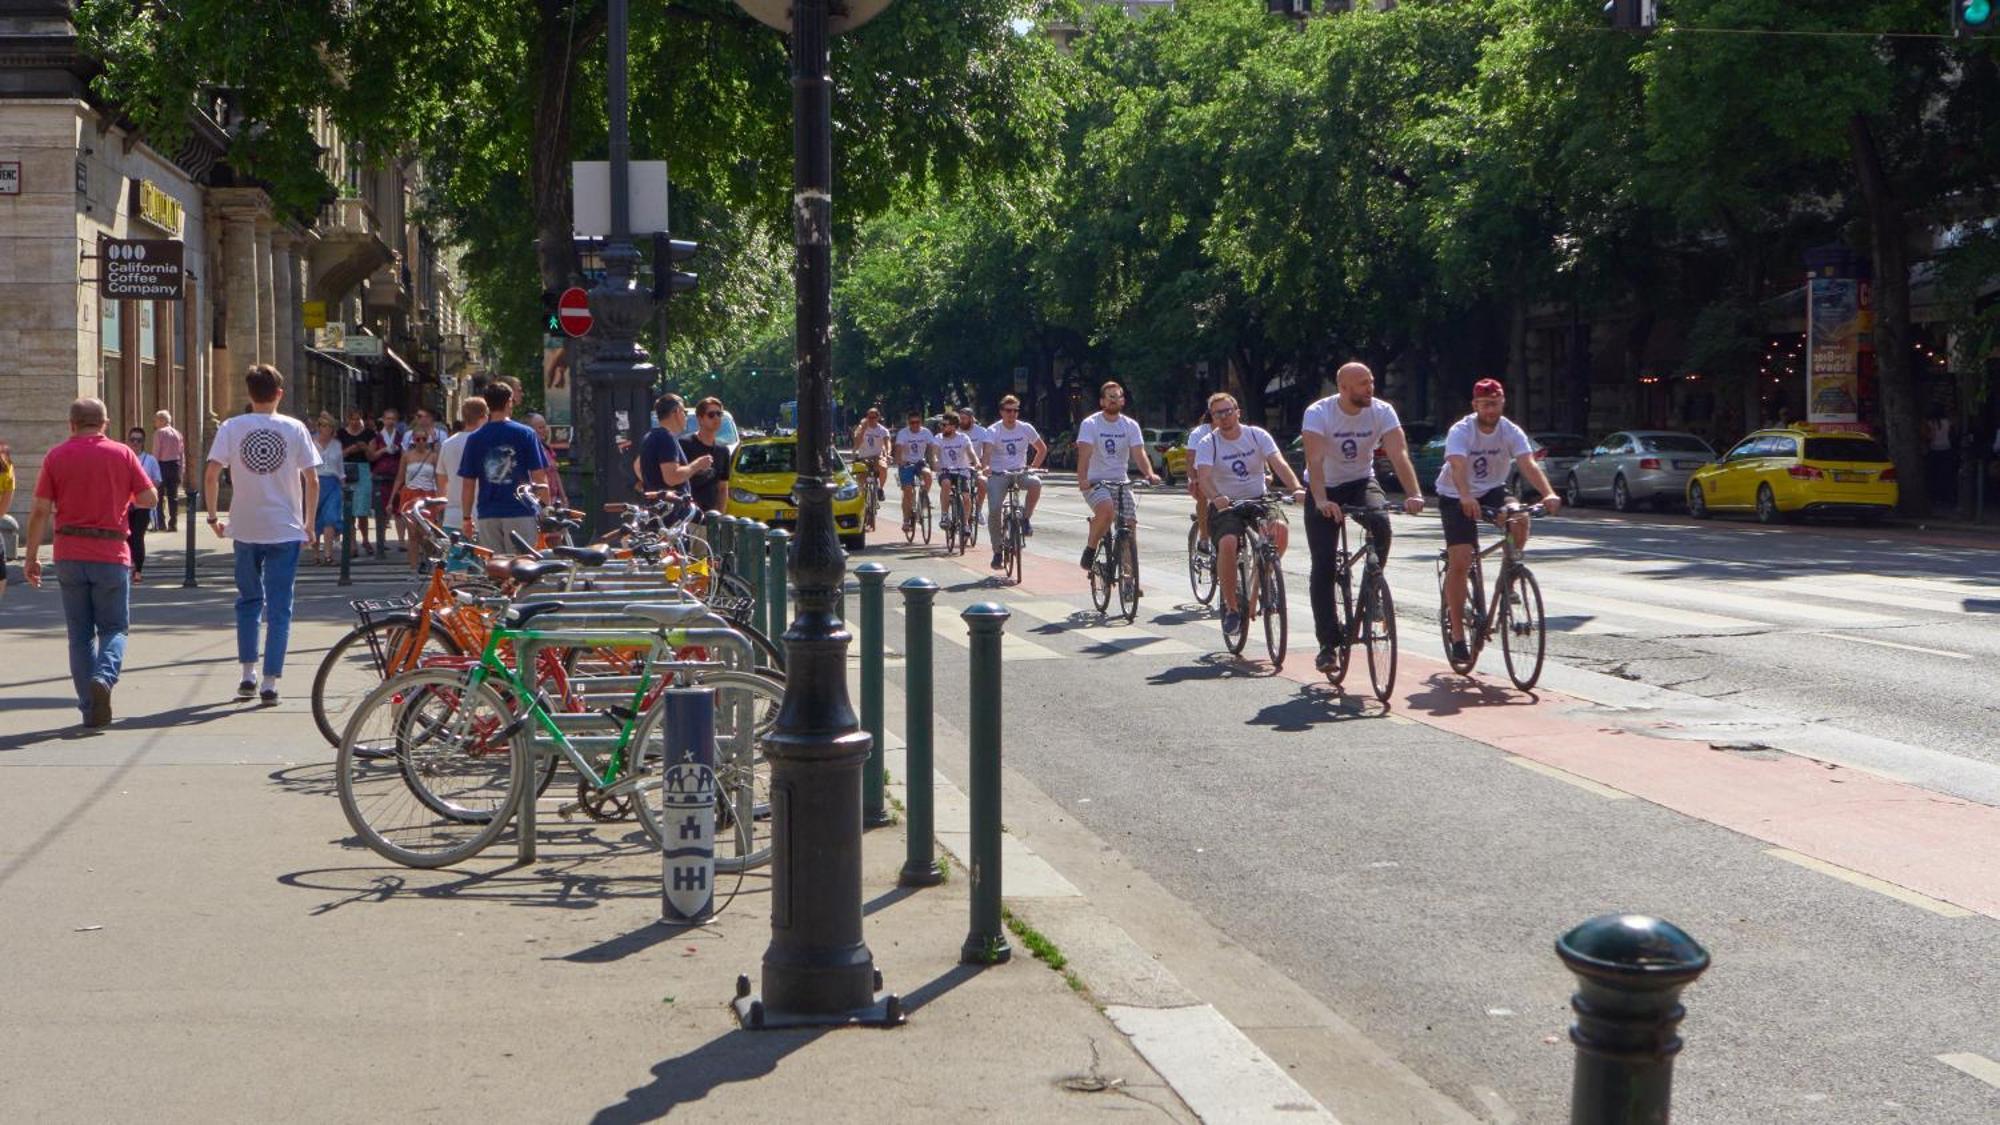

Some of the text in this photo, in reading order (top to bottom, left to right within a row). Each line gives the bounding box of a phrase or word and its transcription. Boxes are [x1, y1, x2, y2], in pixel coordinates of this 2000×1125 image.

[108, 262, 178, 273] California
[108, 273, 157, 283] Coffee
[108, 283, 178, 295] Company
